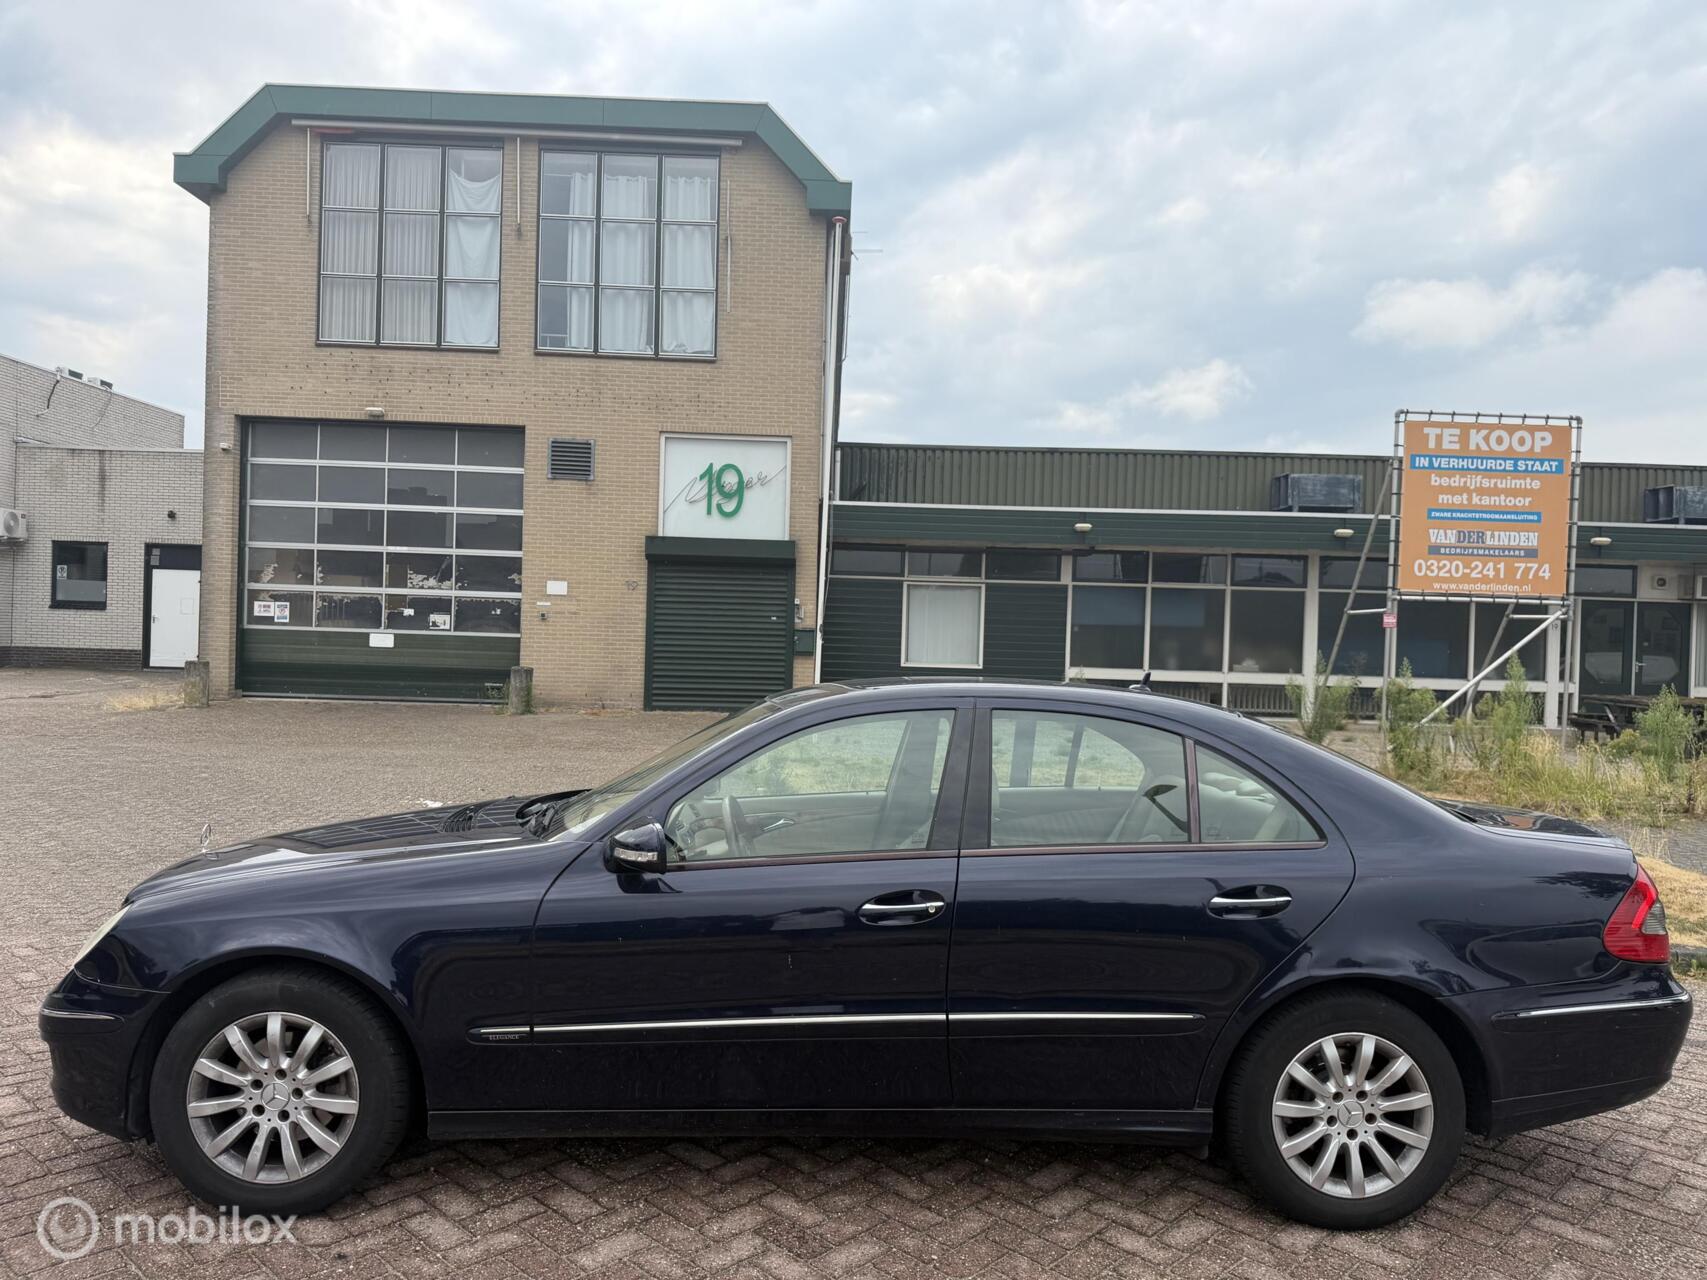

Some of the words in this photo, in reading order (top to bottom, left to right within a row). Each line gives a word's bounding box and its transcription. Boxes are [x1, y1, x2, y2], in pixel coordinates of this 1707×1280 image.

[1424, 428, 1460, 449] TE
[1469, 429, 1552, 452] KOOP
[1415, 457, 1429, 468] IN
[1432, 458, 1514, 470] VERHUURDE
[1517, 460, 1558, 472] STAAT
[1431, 474, 1541, 489] bedrijfsruimte
[699, 462, 745, 518] 19
[1438, 494, 1468, 505] met
[1472, 493, 1532, 506] kantoor
[1440, 547, 1525, 557] BEDRIJFSMAKELAARS
[1413, 559, 1505, 579] 0320-241
[1514, 563, 1551, 580] 774
[1433, 582, 1532, 593] www.vanderlinden.nl
